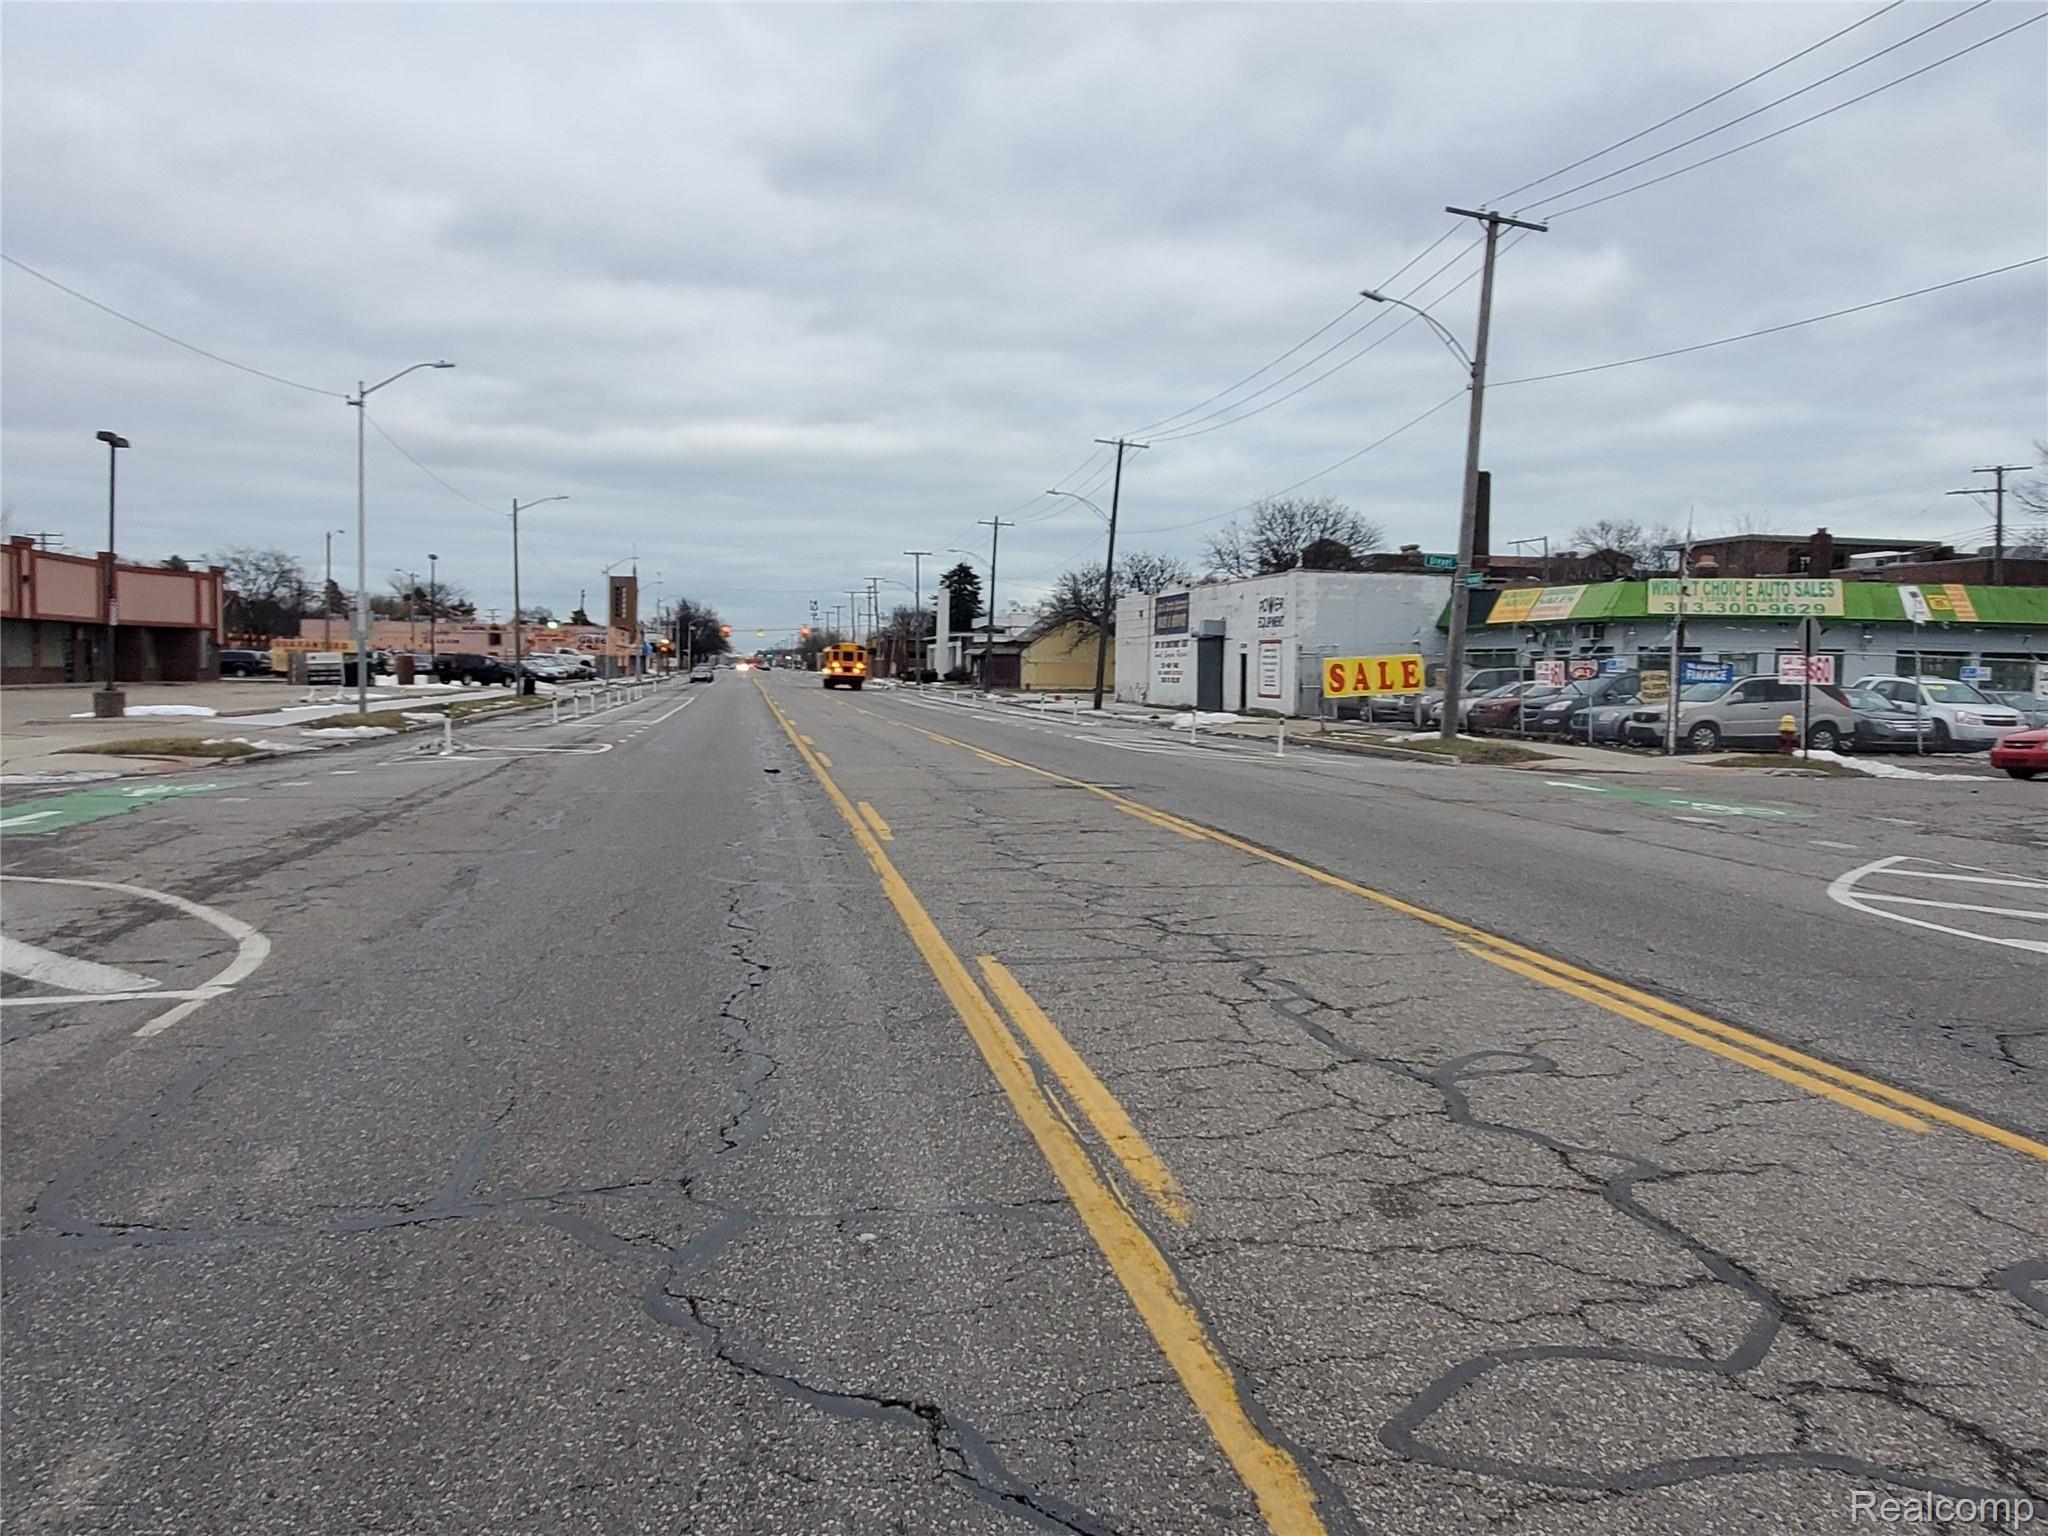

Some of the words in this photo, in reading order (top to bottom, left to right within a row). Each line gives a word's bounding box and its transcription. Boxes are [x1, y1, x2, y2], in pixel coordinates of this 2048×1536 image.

[1652, 581, 1699, 597] WRIGT
[1757, 581, 1791, 598] AUTO
[1794, 582, 1836, 598] SALES
[1329, 660, 1421, 693] SALE
[1686, 669, 1728, 681] FINANCE
